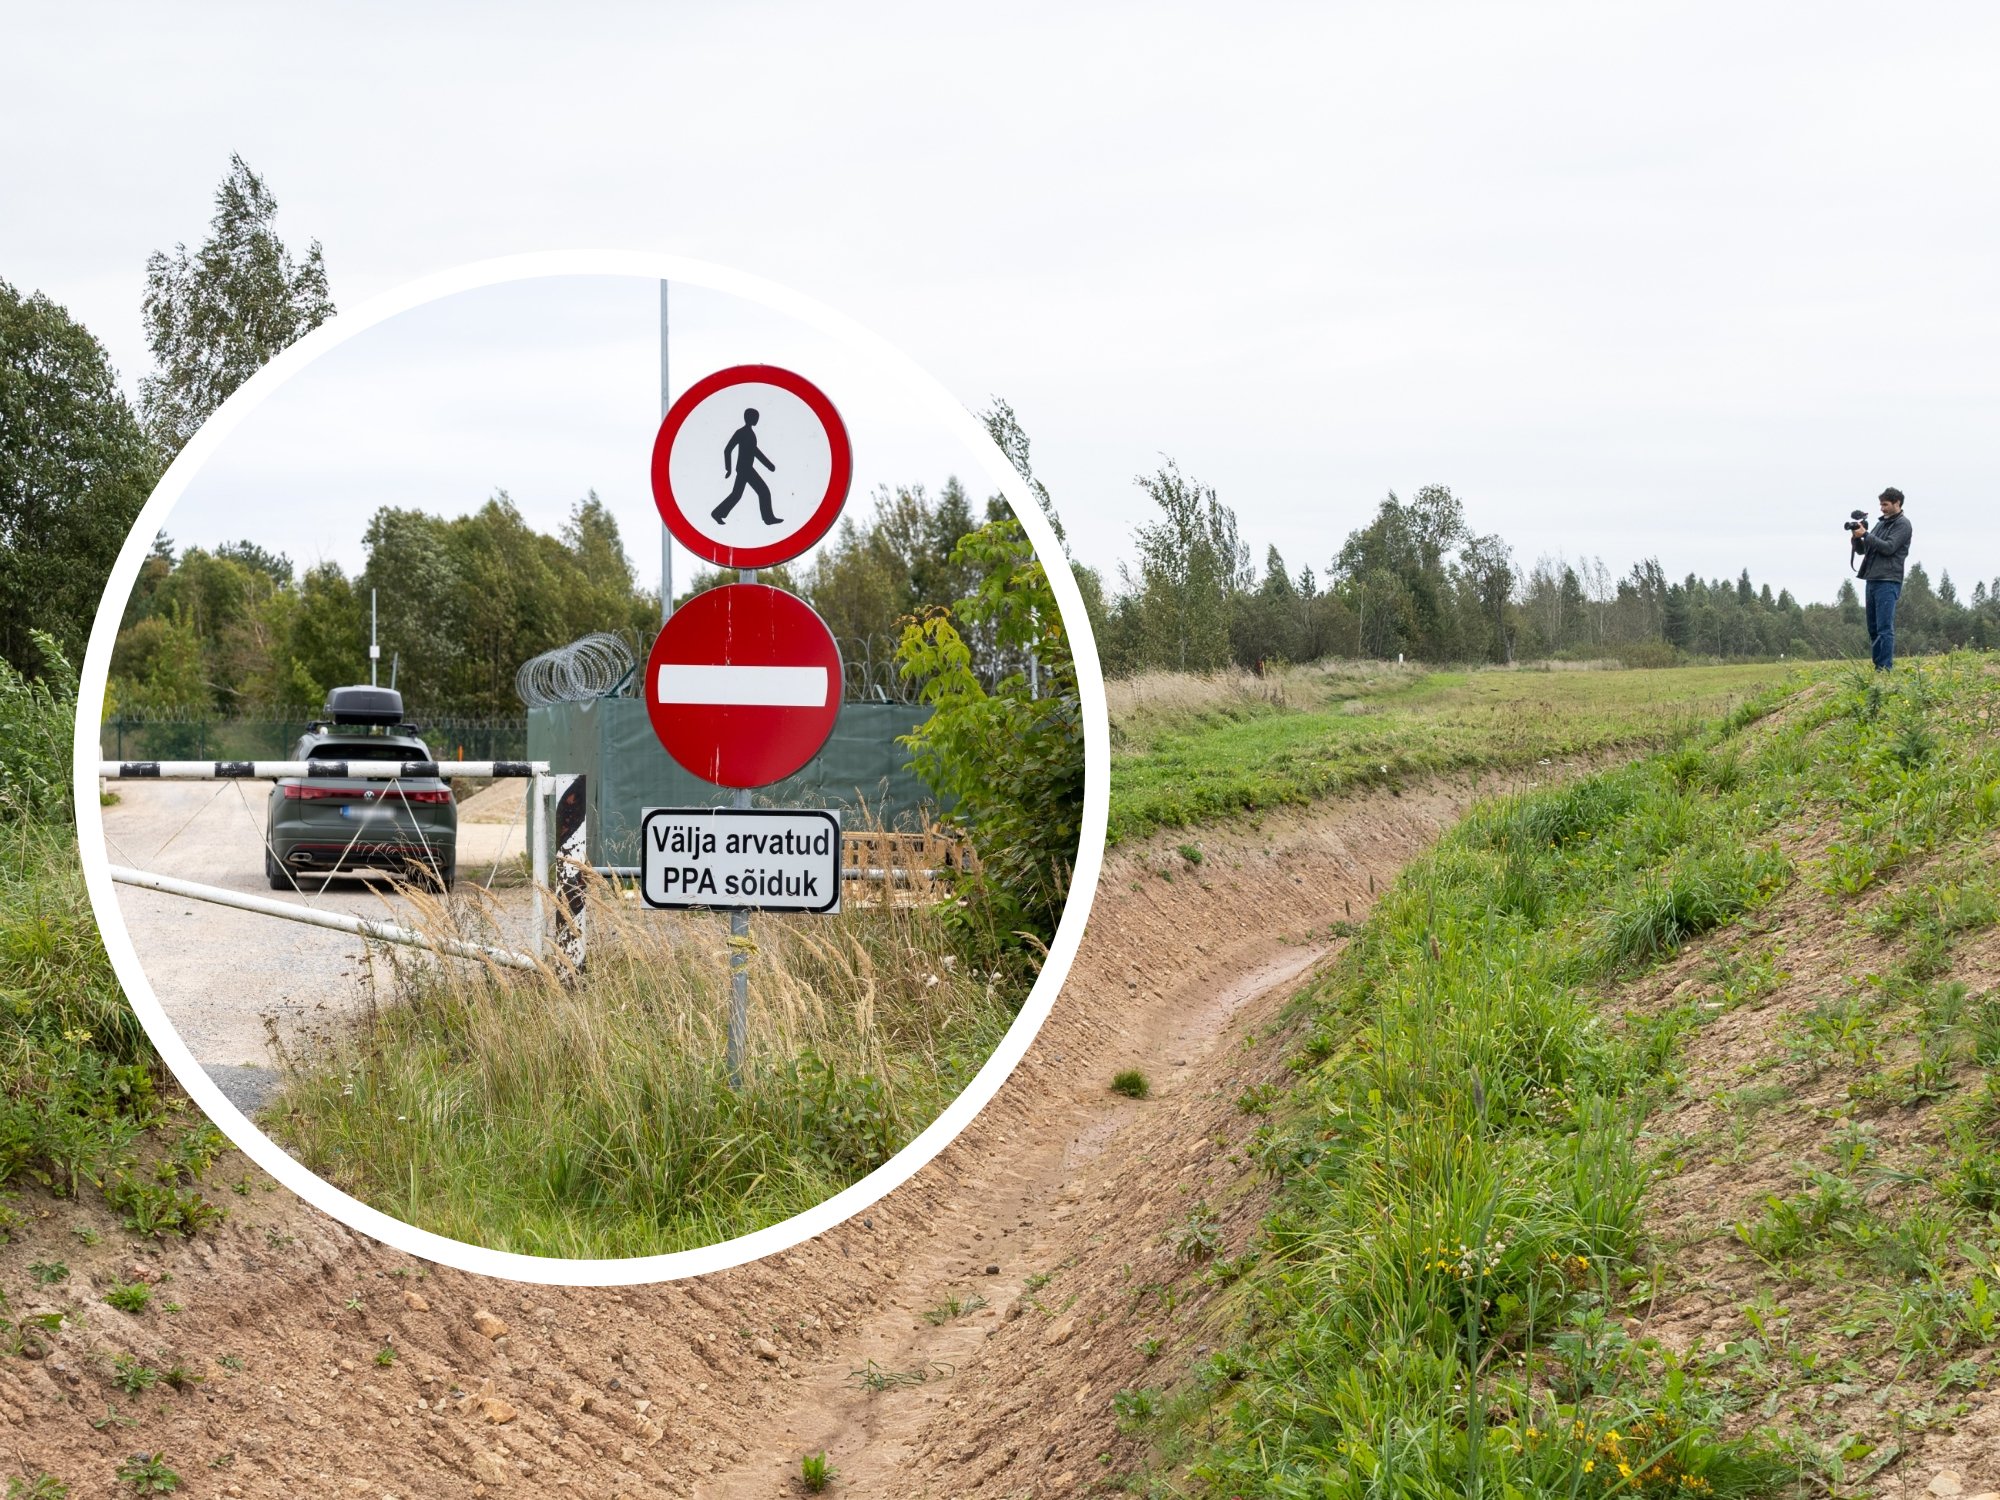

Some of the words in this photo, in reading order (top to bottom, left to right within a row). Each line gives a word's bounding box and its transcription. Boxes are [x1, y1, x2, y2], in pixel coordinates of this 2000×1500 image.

[653, 825, 717, 861] Välja
[725, 828, 830, 856] arvatud
[663, 866, 718, 895] PPA
[725, 868, 818, 897] sõiduk
